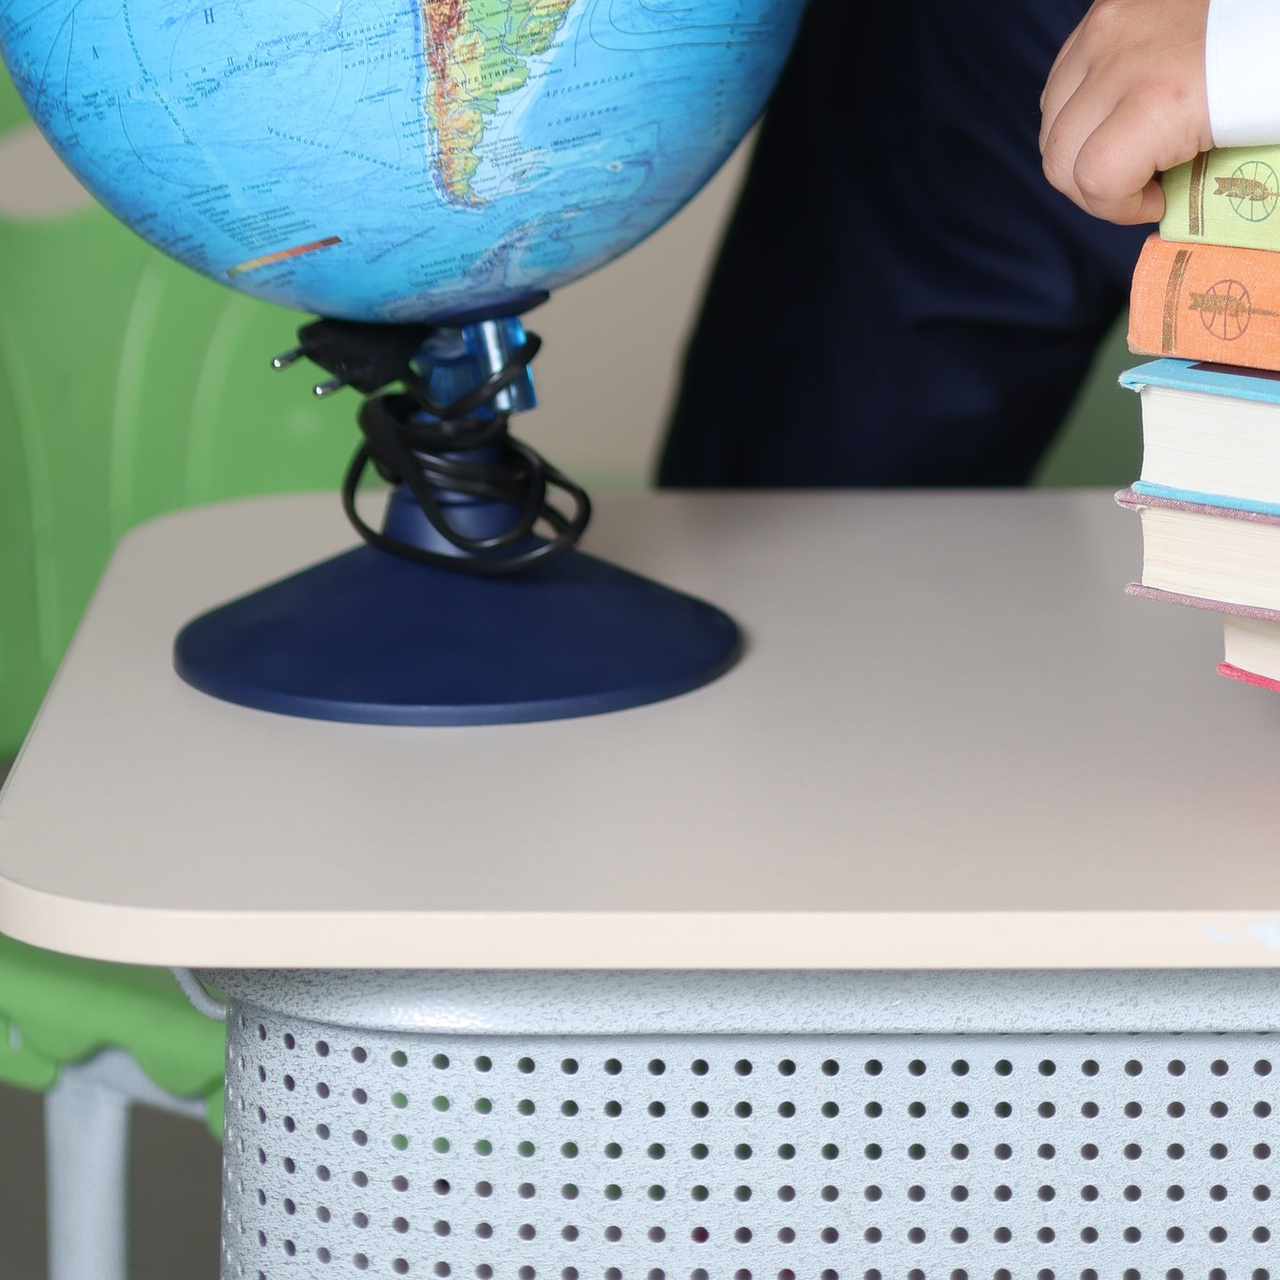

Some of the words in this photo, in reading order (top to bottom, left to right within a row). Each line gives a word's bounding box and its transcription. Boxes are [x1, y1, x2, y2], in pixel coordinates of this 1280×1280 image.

[338, 19, 399, 40] Чилийская
[223, 57, 279, 79] Сала-и-Гомес
[344, 48, 406, 70] котловина
[455, 66, 515, 88] АРГЕНТИНА
[544, 72, 634, 98] Аргентинская
[267, 125, 330, 150] Чилийское
